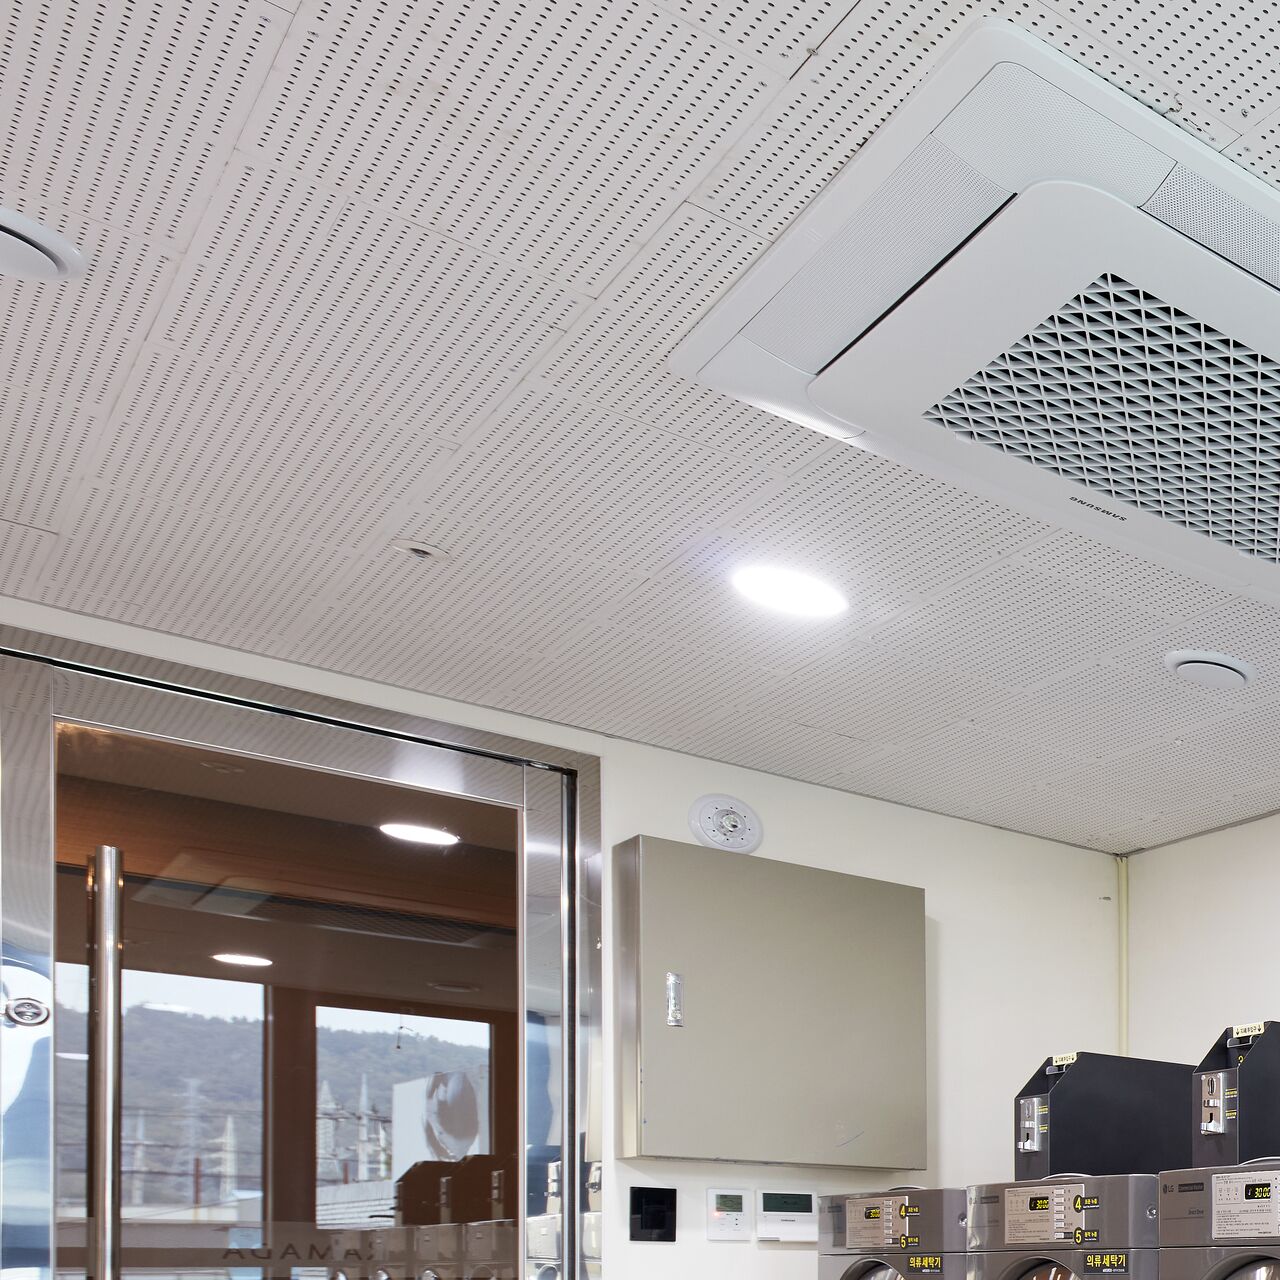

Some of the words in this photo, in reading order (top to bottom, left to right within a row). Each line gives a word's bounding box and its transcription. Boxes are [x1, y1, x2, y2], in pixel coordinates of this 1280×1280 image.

[1069, 497, 1127, 521] SAMSUNG
[1075, 1197, 1082, 1210] 4
[900, 1204, 906, 1217] 4
[901, 1236, 906, 1248] 5
[1075, 1229, 1082, 1244] 5
